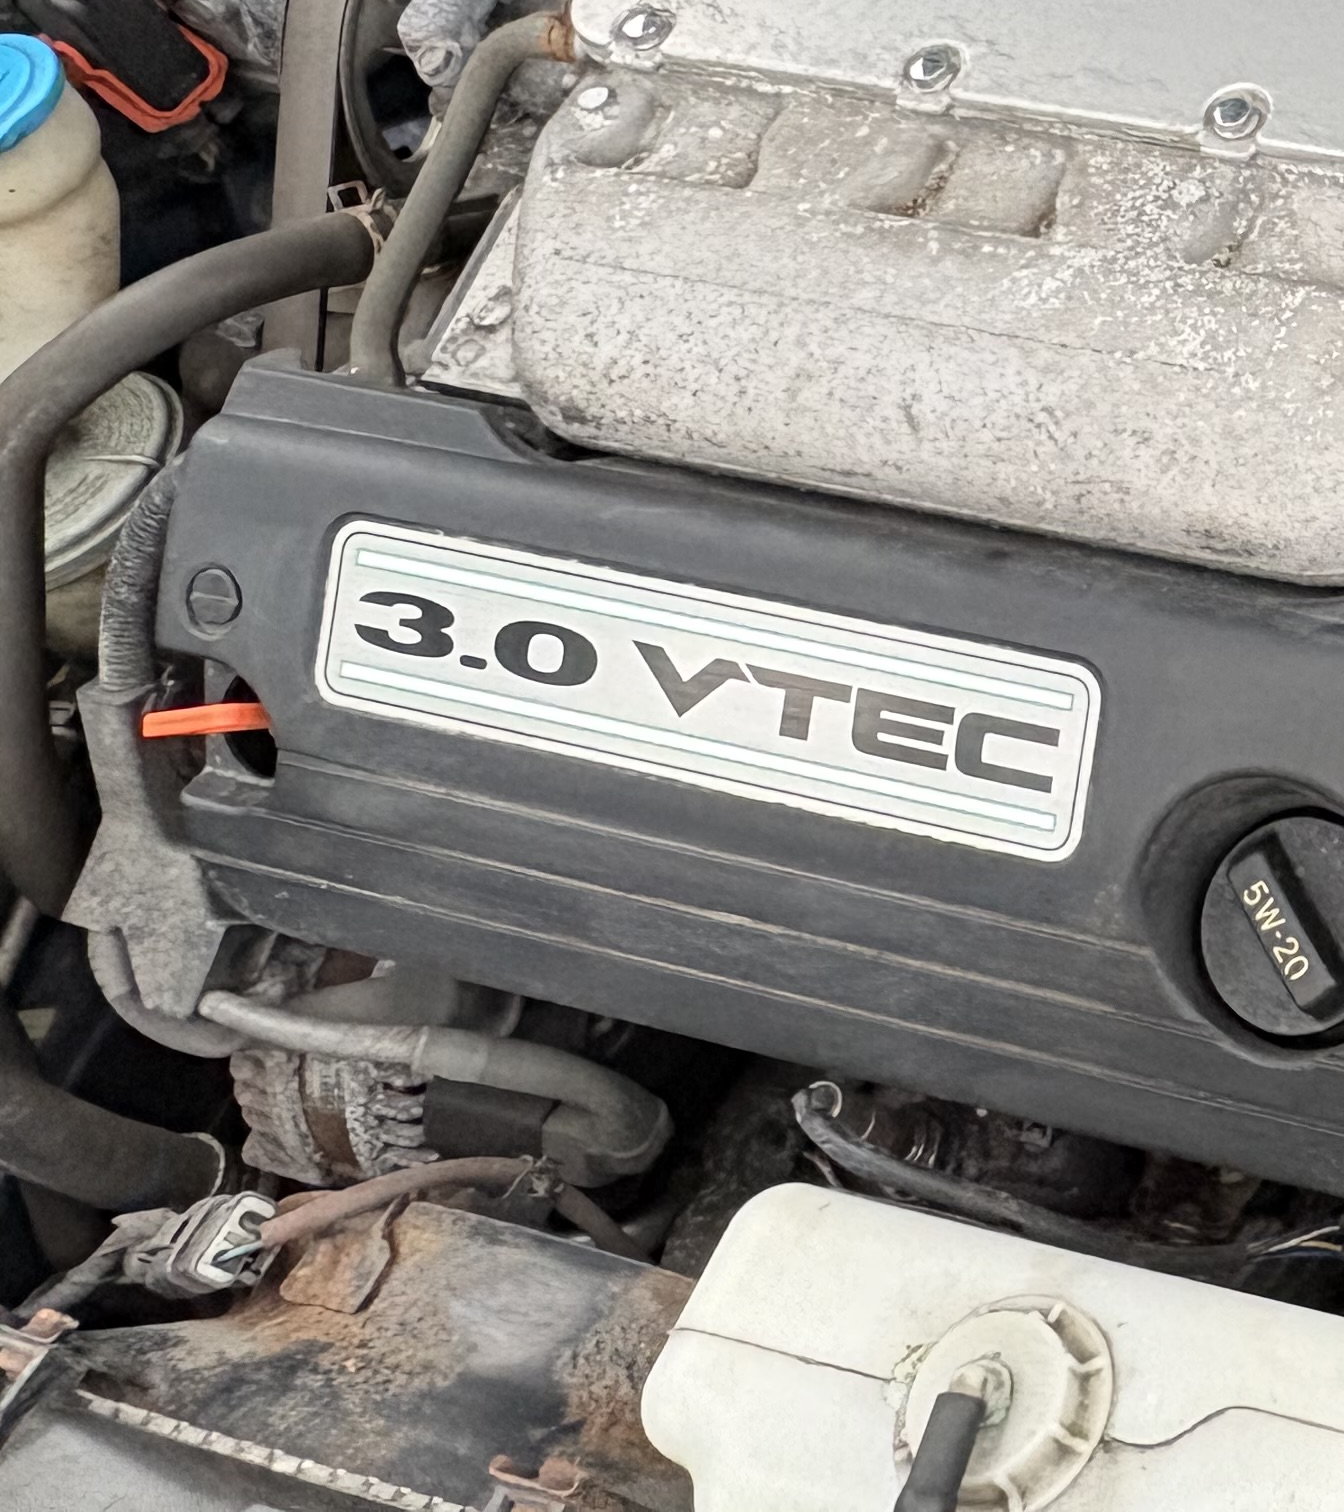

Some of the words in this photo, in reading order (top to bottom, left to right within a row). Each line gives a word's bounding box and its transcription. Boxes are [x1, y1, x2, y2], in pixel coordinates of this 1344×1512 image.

[353, 590, 598, 686] 3.0
[632, 638, 1061, 793] VTEC
[1243, 880, 1309, 981] 5W-20
